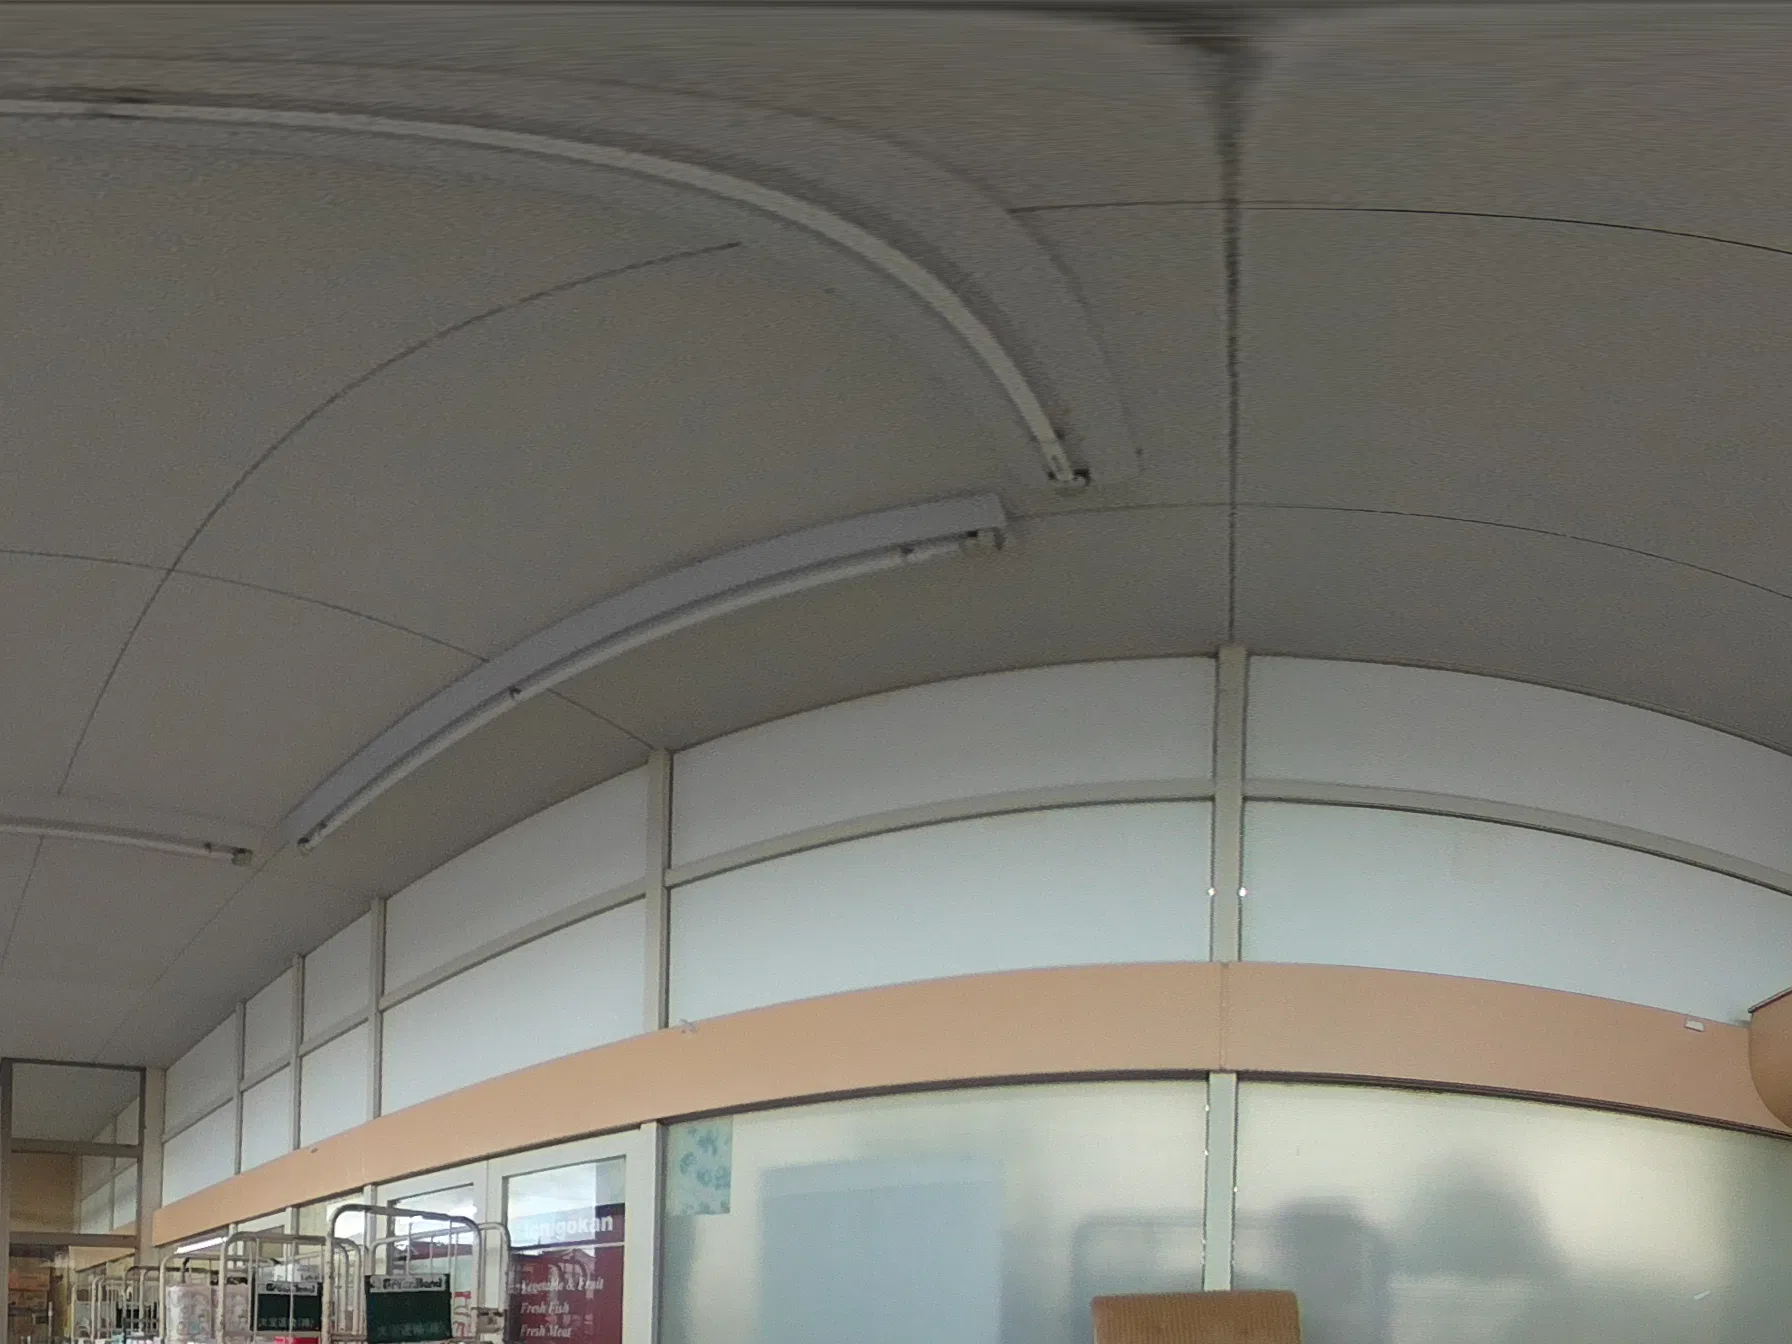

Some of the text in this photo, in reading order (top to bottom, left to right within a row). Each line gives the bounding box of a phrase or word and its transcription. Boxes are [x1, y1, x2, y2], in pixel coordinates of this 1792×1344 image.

[524, 1214, 613, 1239] Ichigokan
[520, 1300, 570, 1315] Fresh Fish
[520, 1324, 546, 1338] Fresh
